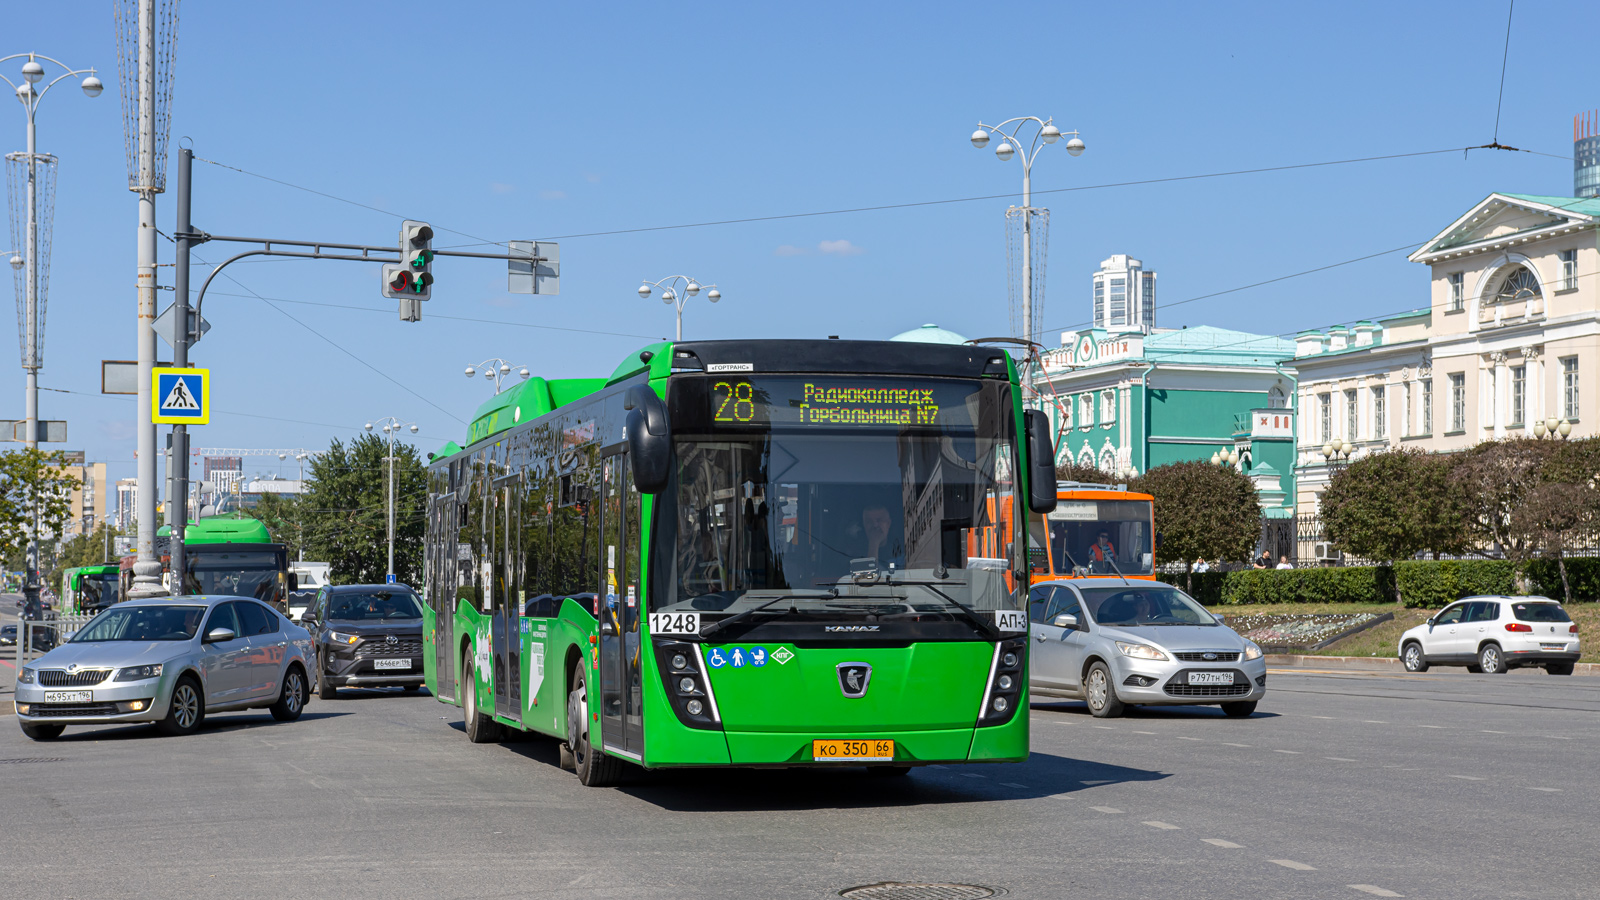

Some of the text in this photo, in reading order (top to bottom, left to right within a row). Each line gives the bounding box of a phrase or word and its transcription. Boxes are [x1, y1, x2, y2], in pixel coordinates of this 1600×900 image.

[714, 382, 754, 421] 28
[804, 383, 933, 404] Радиоколледж
[800, 403, 939, 424] Горбольница N7
[652, 614, 696, 632] 1248
[999, 613, 1026, 629] АП-3
[1191, 673, 1220, 681] Р797ТН
[47, 692, 76, 701] М695ХТ
[820, 741, 889, 755] КО 350 66
